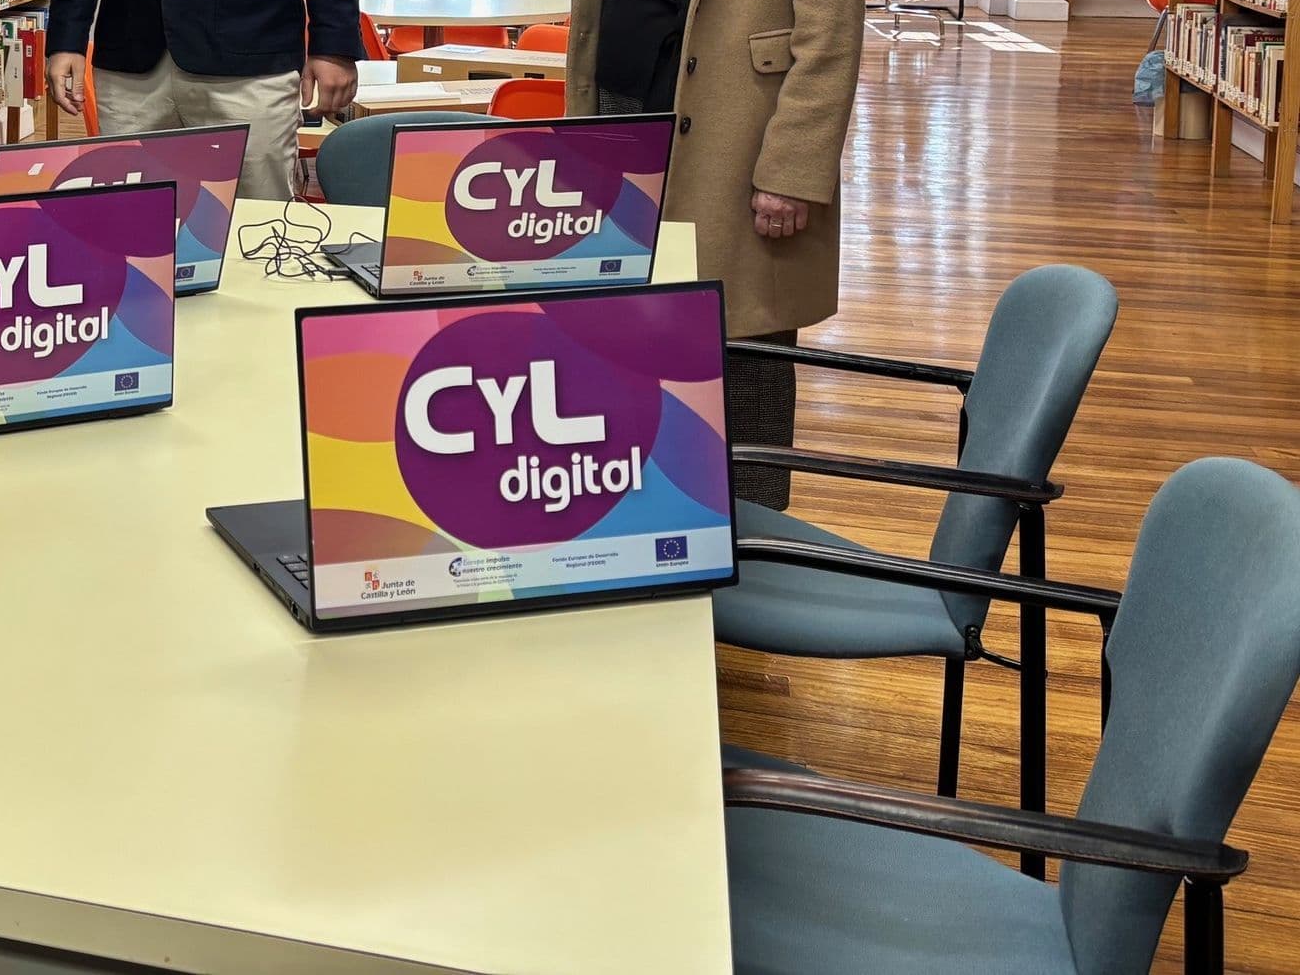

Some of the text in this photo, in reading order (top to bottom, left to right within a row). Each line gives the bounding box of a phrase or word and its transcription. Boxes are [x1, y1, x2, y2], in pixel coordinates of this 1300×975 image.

[508, 209, 602, 244] digital
[0, 306, 109, 358] digital
[499, 446, 643, 513] digital
[462, 566, 485, 574] nuestro
[361, 587, 416, 600] Castilla y León
[381, 579, 415, 589] Junta de
